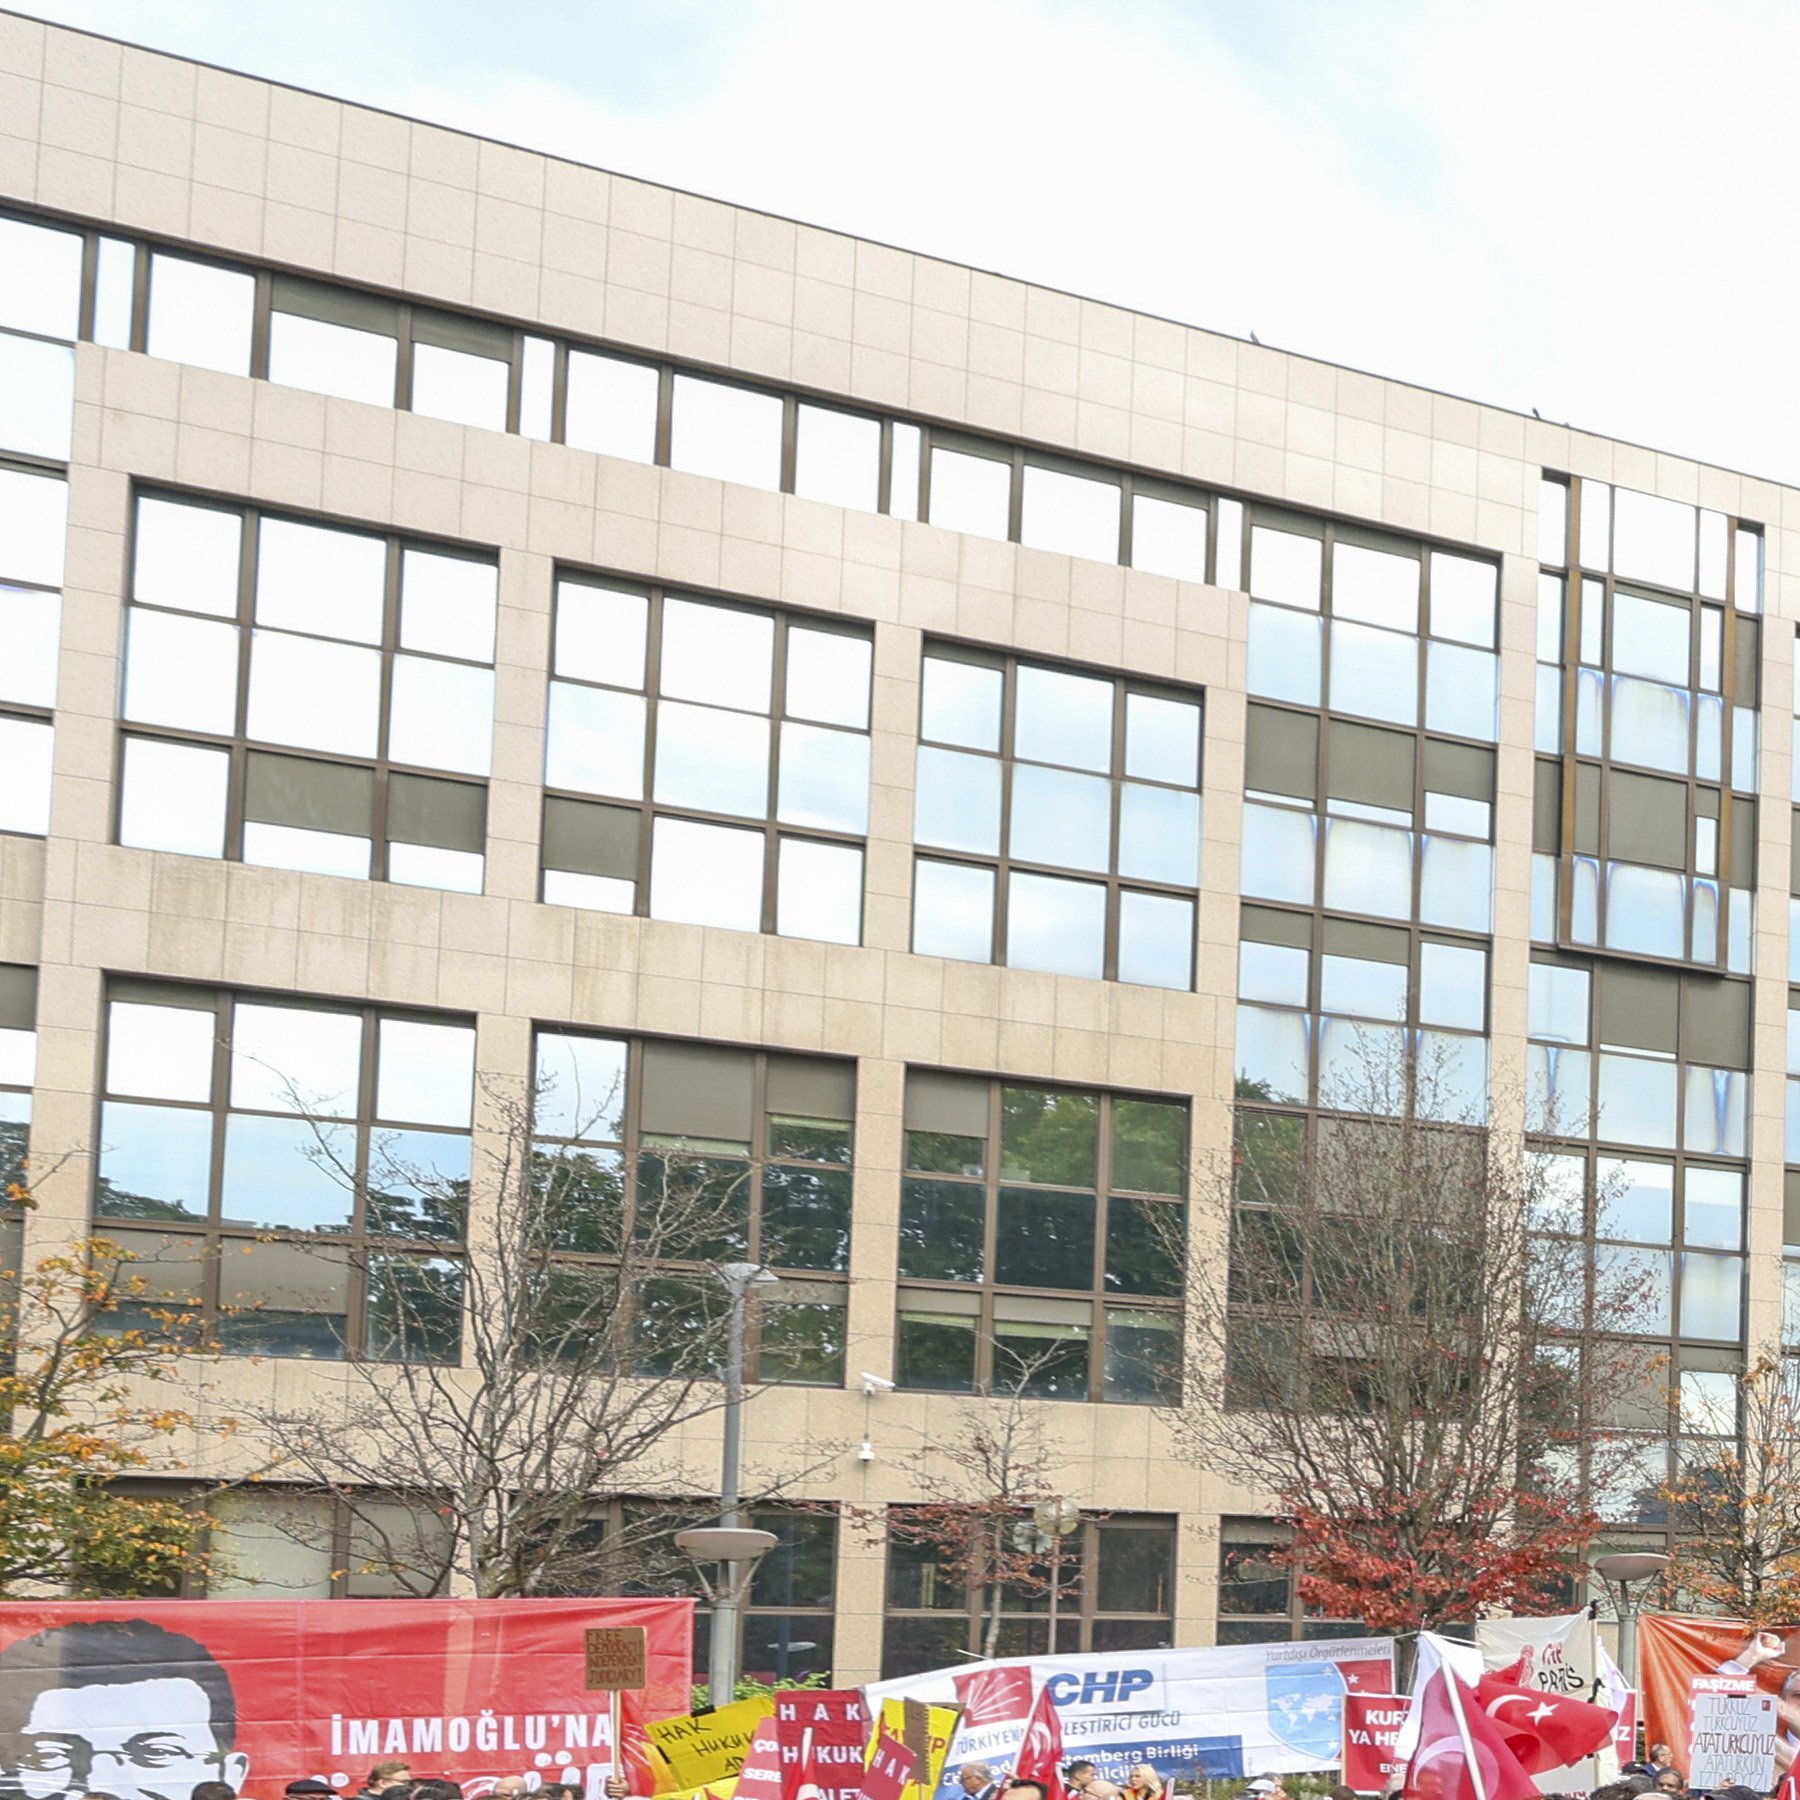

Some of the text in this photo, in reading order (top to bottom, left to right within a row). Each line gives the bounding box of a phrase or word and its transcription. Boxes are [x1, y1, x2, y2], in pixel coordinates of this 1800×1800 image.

[1047, 1669, 1154, 1707] CHP
[1139, 1709, 1181, 1730] GÜCÜ
[657, 1718, 711, 1744] HAK
[1349, 1729, 1371, 1745] YA
[782, 1745, 863, 1763] HKUK
[1145, 1743, 1199, 1760] Birliği
